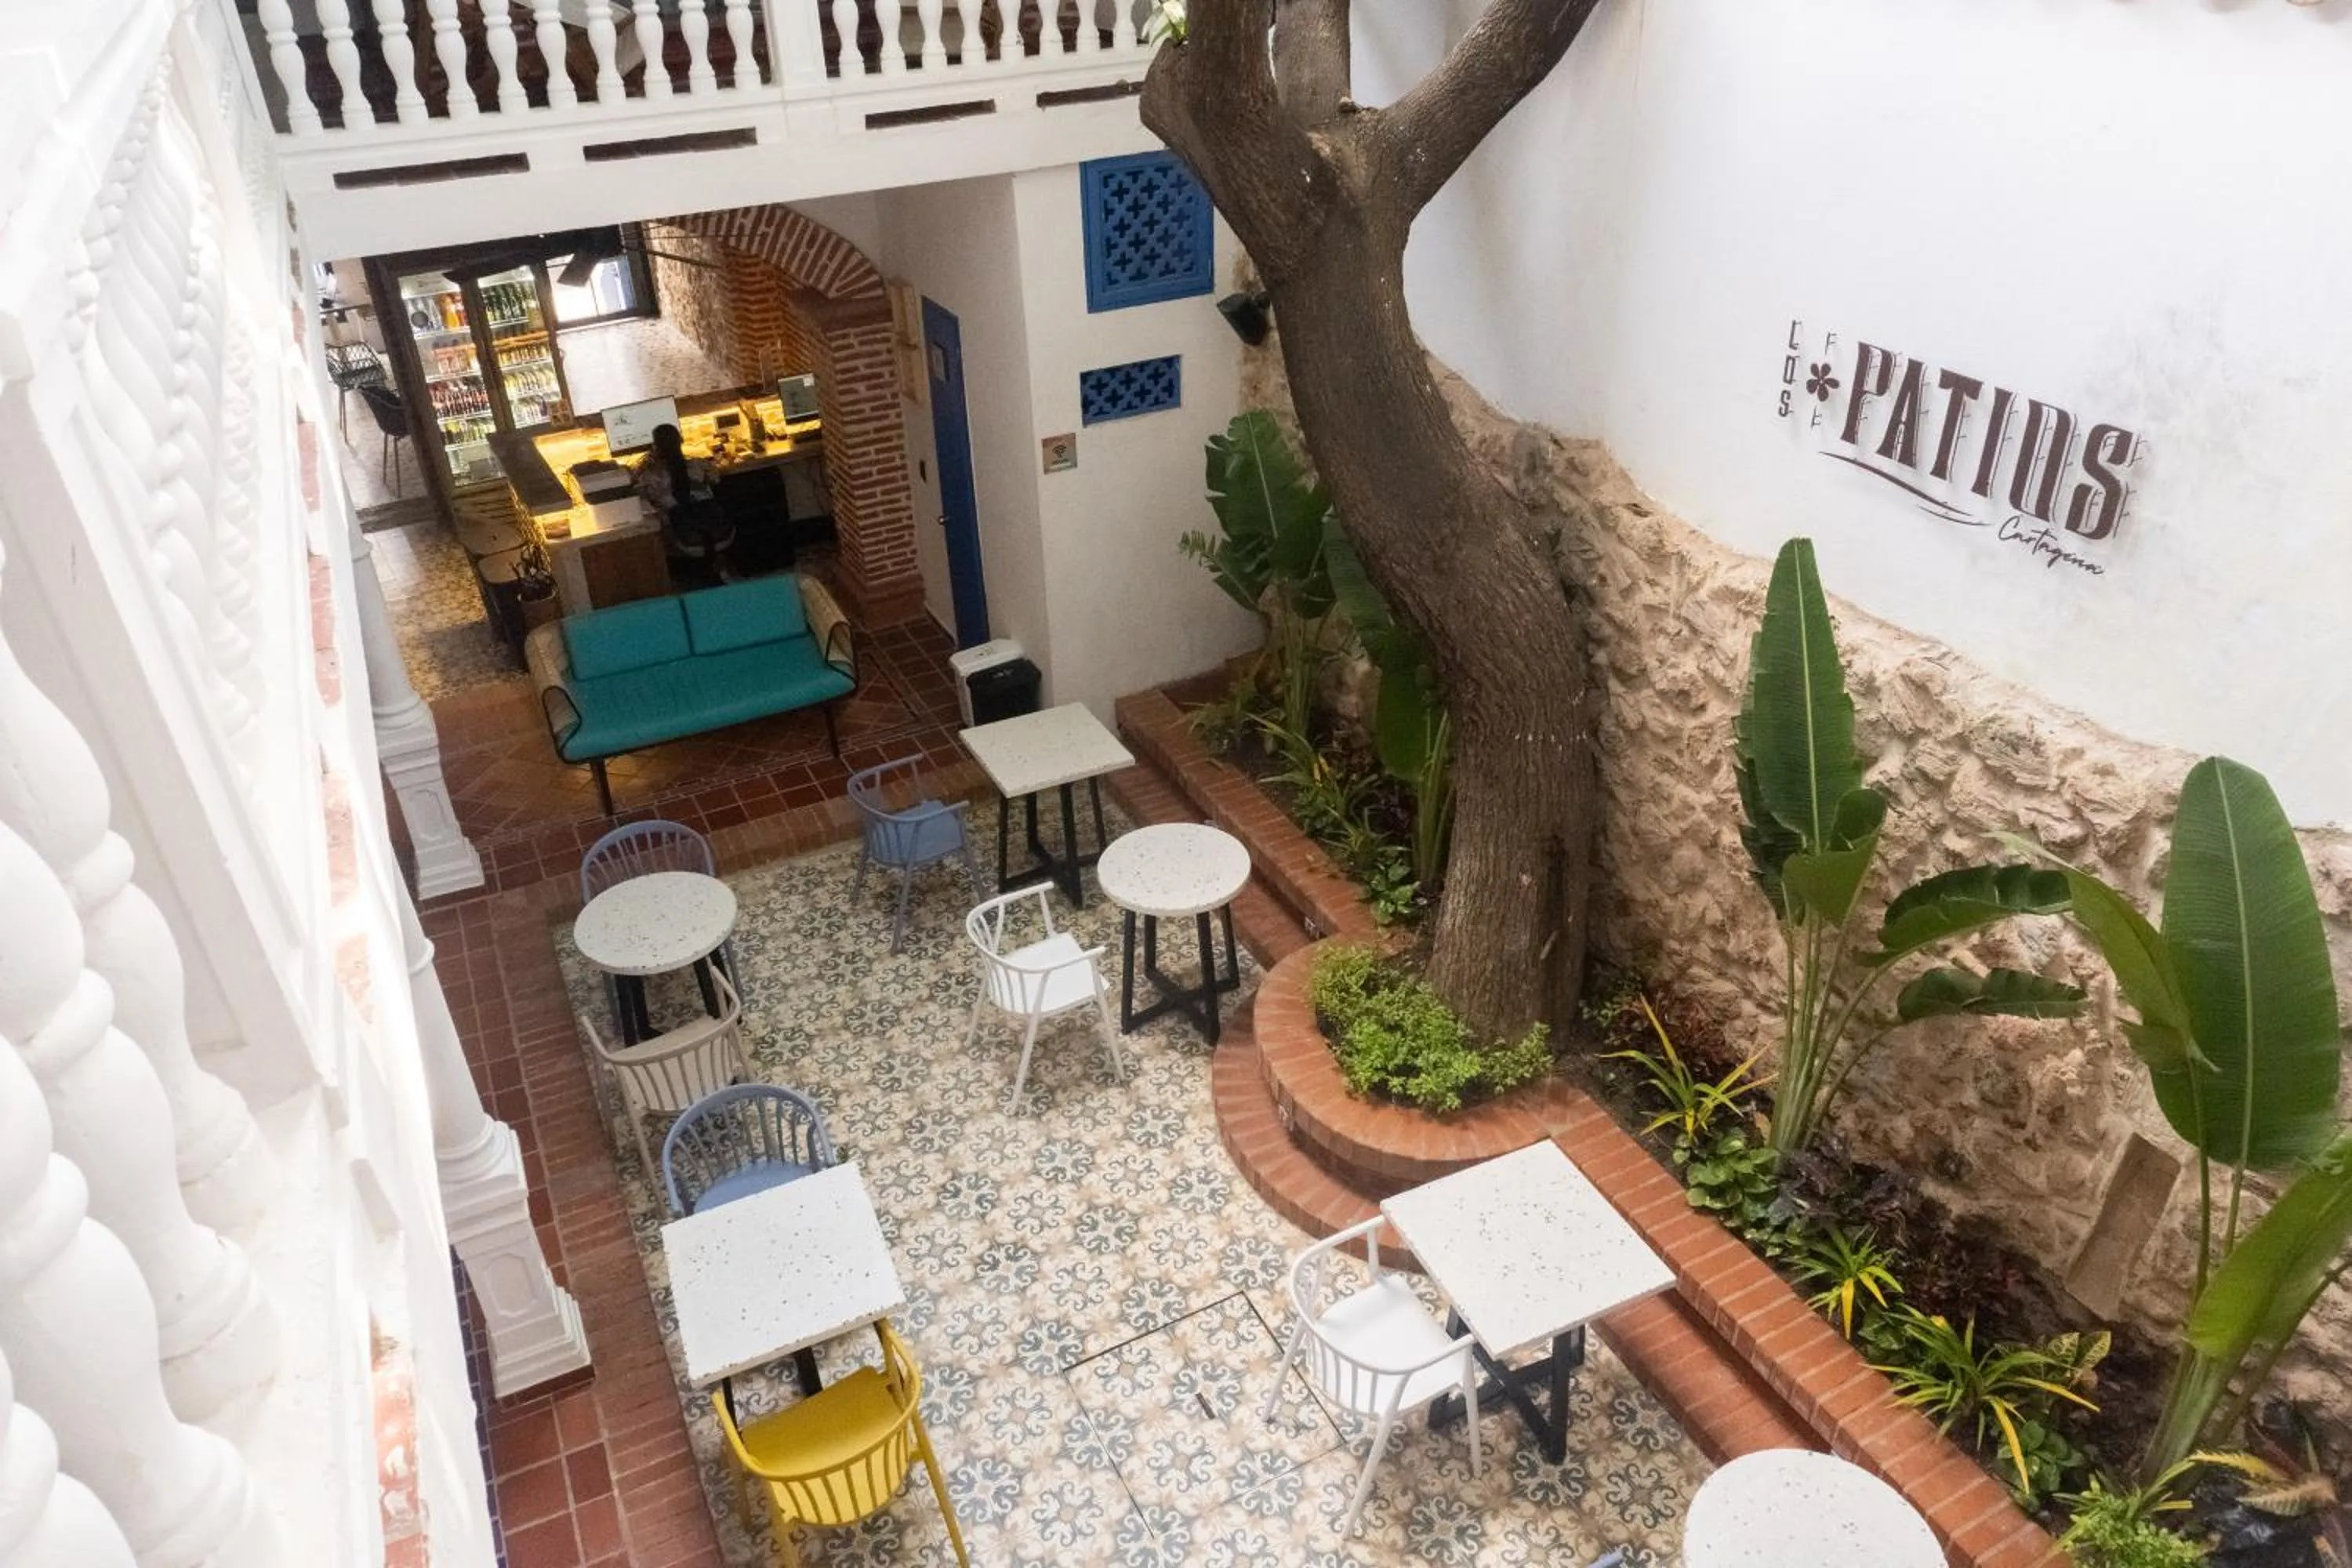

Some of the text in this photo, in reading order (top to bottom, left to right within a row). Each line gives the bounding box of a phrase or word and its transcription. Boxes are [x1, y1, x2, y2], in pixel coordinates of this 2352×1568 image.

[1778, 319, 2135, 541] LOS PATIOS
[1998, 515, 2105, 575] Cartagena
